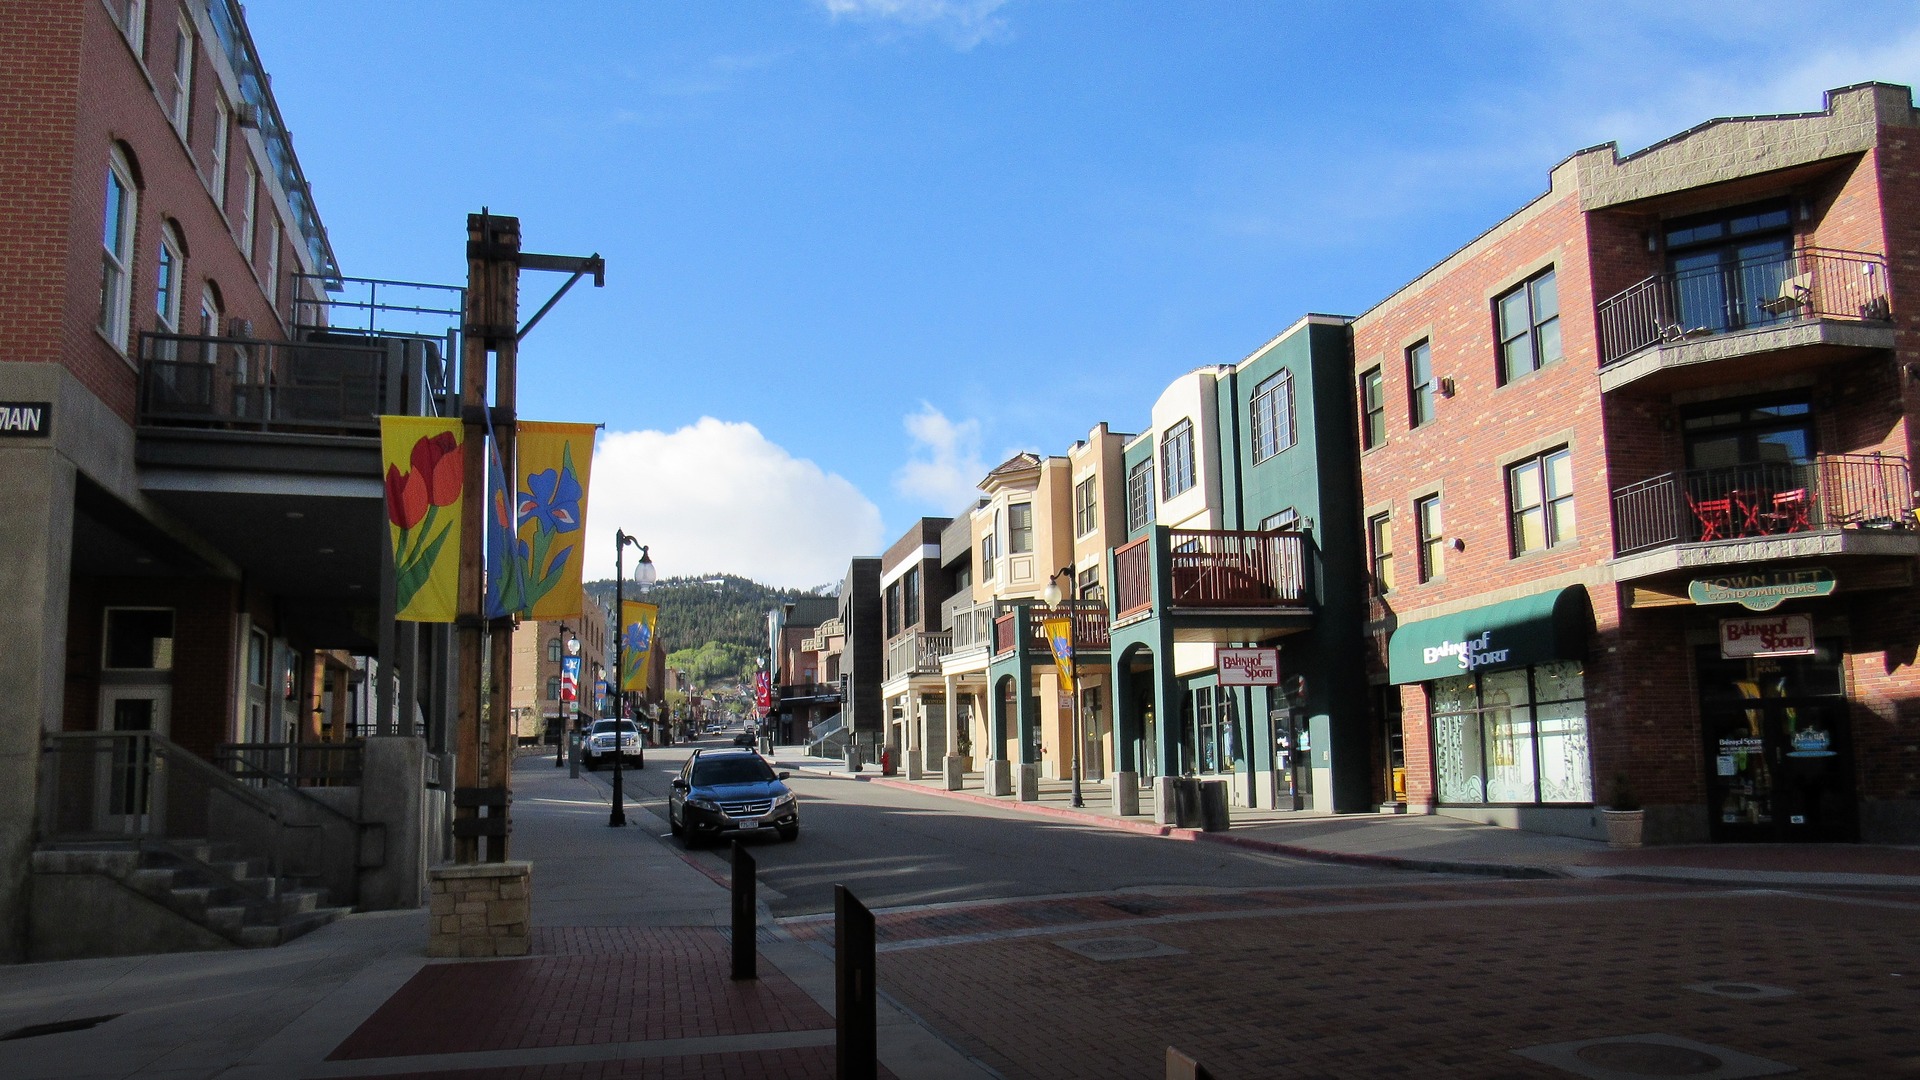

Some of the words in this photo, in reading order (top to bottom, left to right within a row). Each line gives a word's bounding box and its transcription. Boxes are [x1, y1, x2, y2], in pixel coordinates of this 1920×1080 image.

[1702, 575, 1766, 592] TOWN
[1775, 570, 1822, 585] LIFT
[1708, 584, 1817, 600] CONDOMINIUMS
